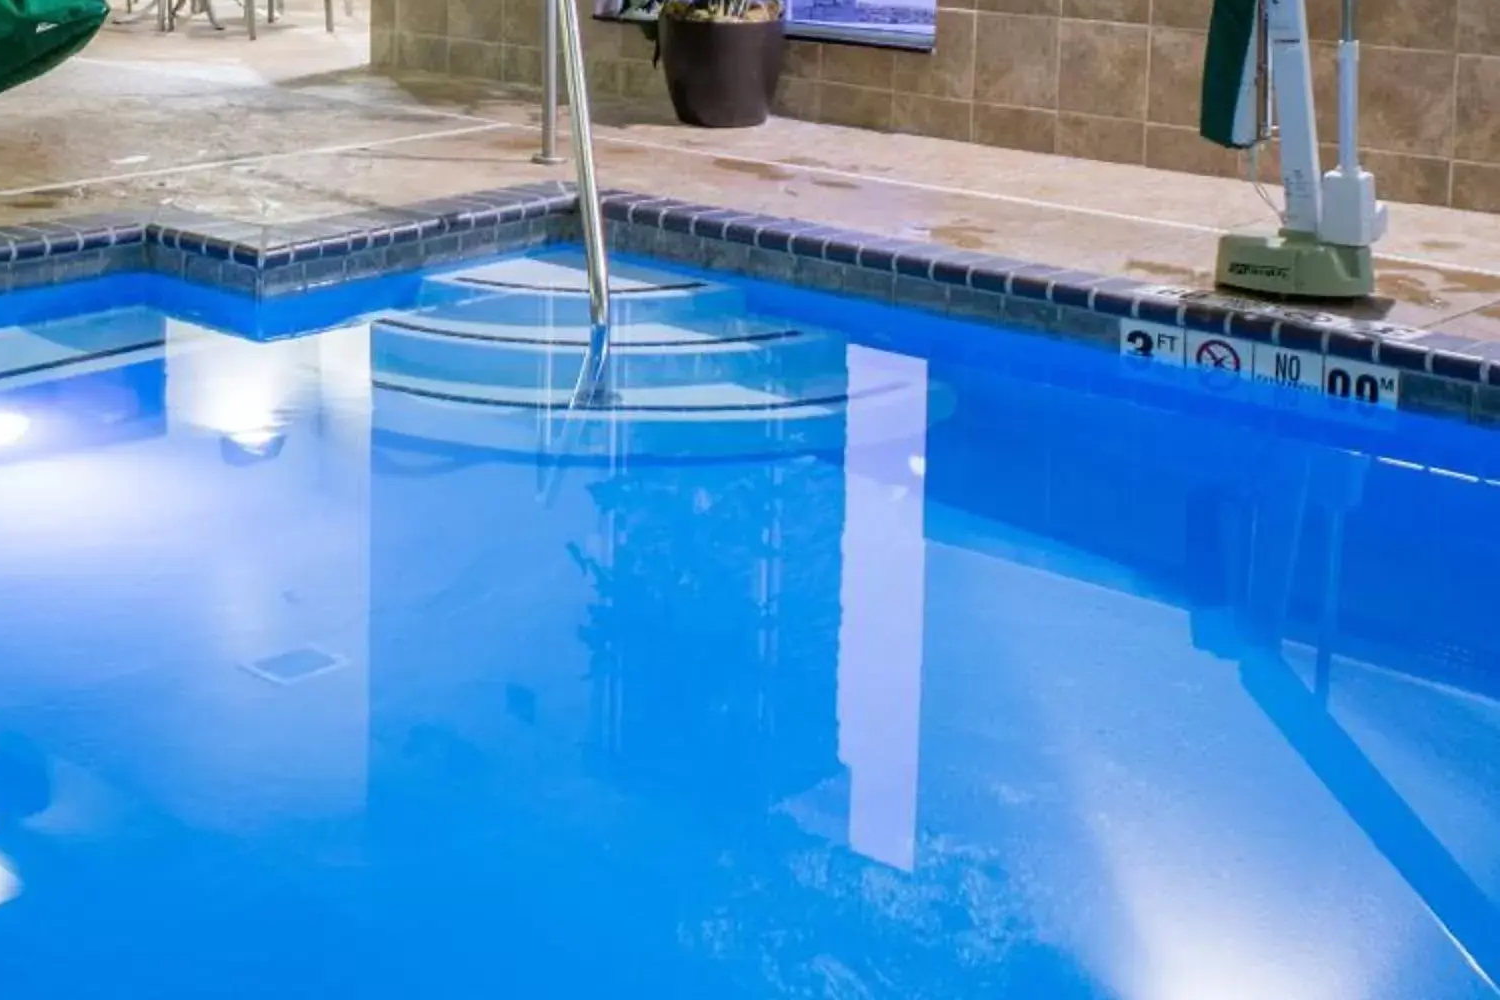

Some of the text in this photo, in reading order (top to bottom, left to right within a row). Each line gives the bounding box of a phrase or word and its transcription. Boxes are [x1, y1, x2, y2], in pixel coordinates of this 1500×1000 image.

[1157, 333, 1179, 352] FT
[1275, 352, 1300, 384] NO
[1380, 376, 1395, 392] M
